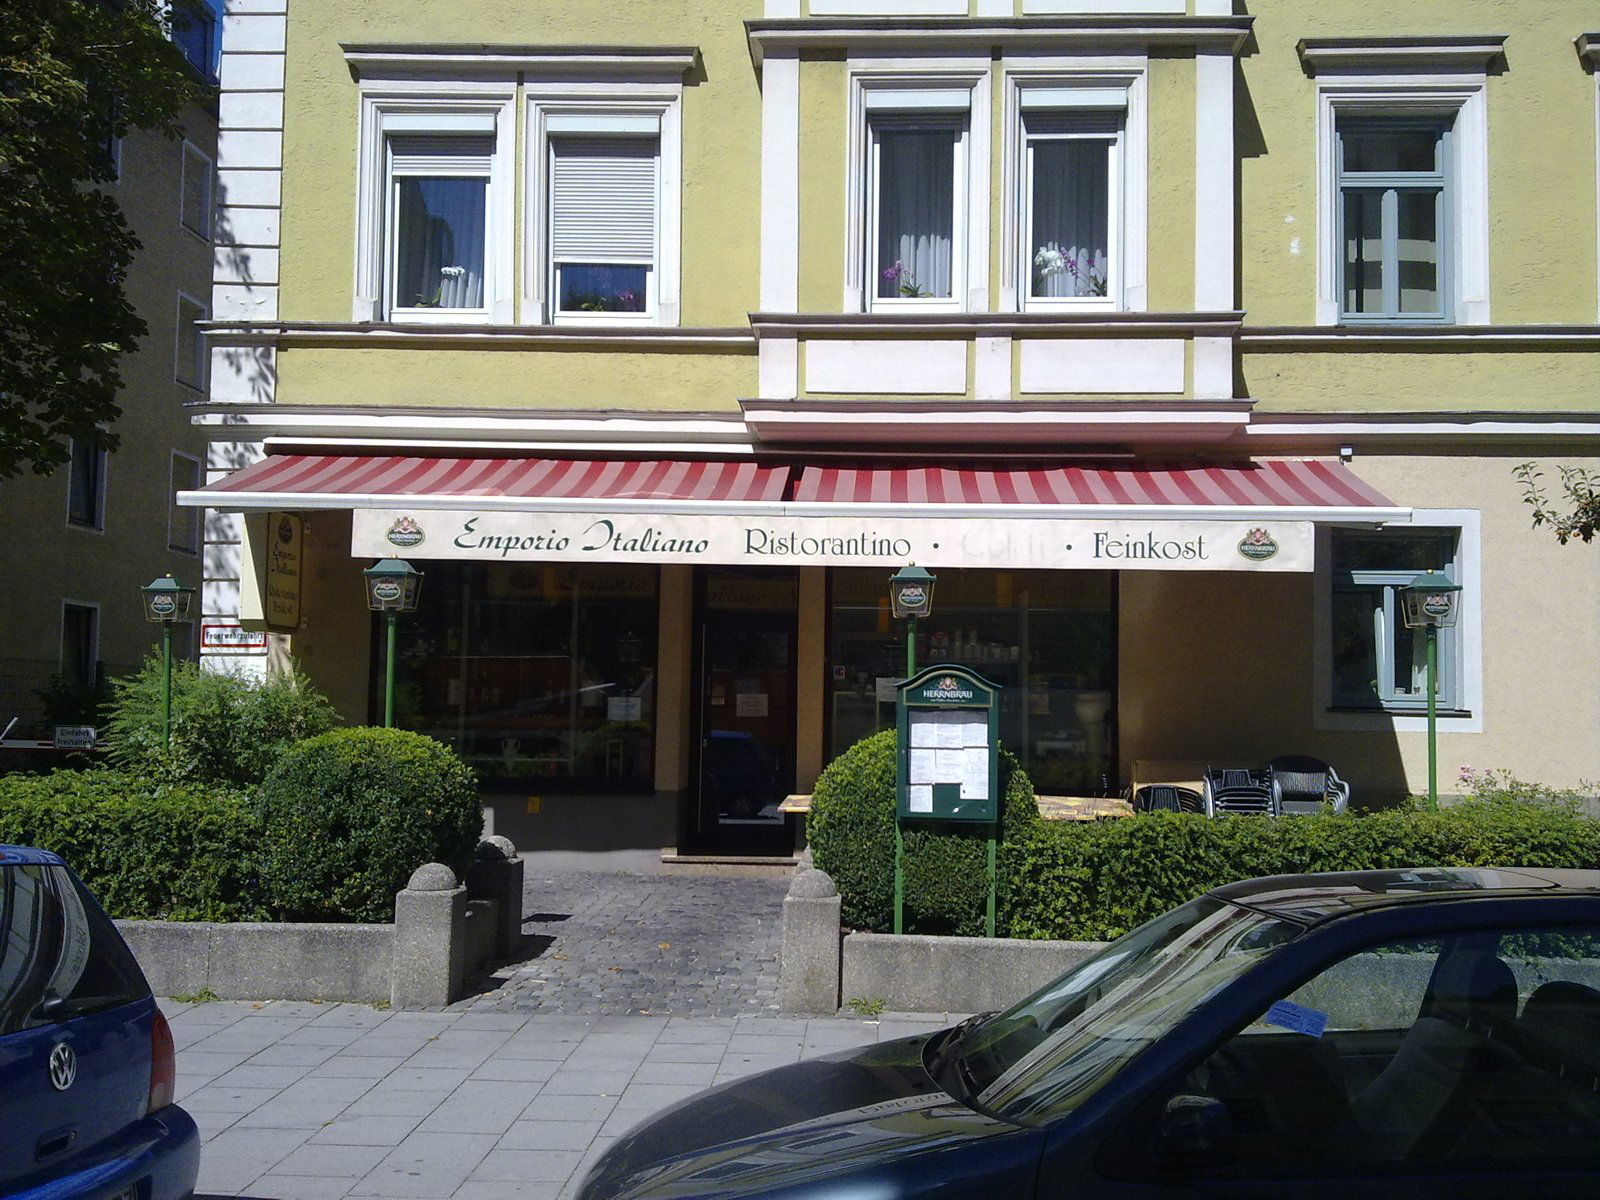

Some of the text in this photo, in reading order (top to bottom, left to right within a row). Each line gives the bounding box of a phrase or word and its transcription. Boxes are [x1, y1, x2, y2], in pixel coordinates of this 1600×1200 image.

[454, 517, 1210, 559] Emporio Italiano Ristorantino Feinkost
